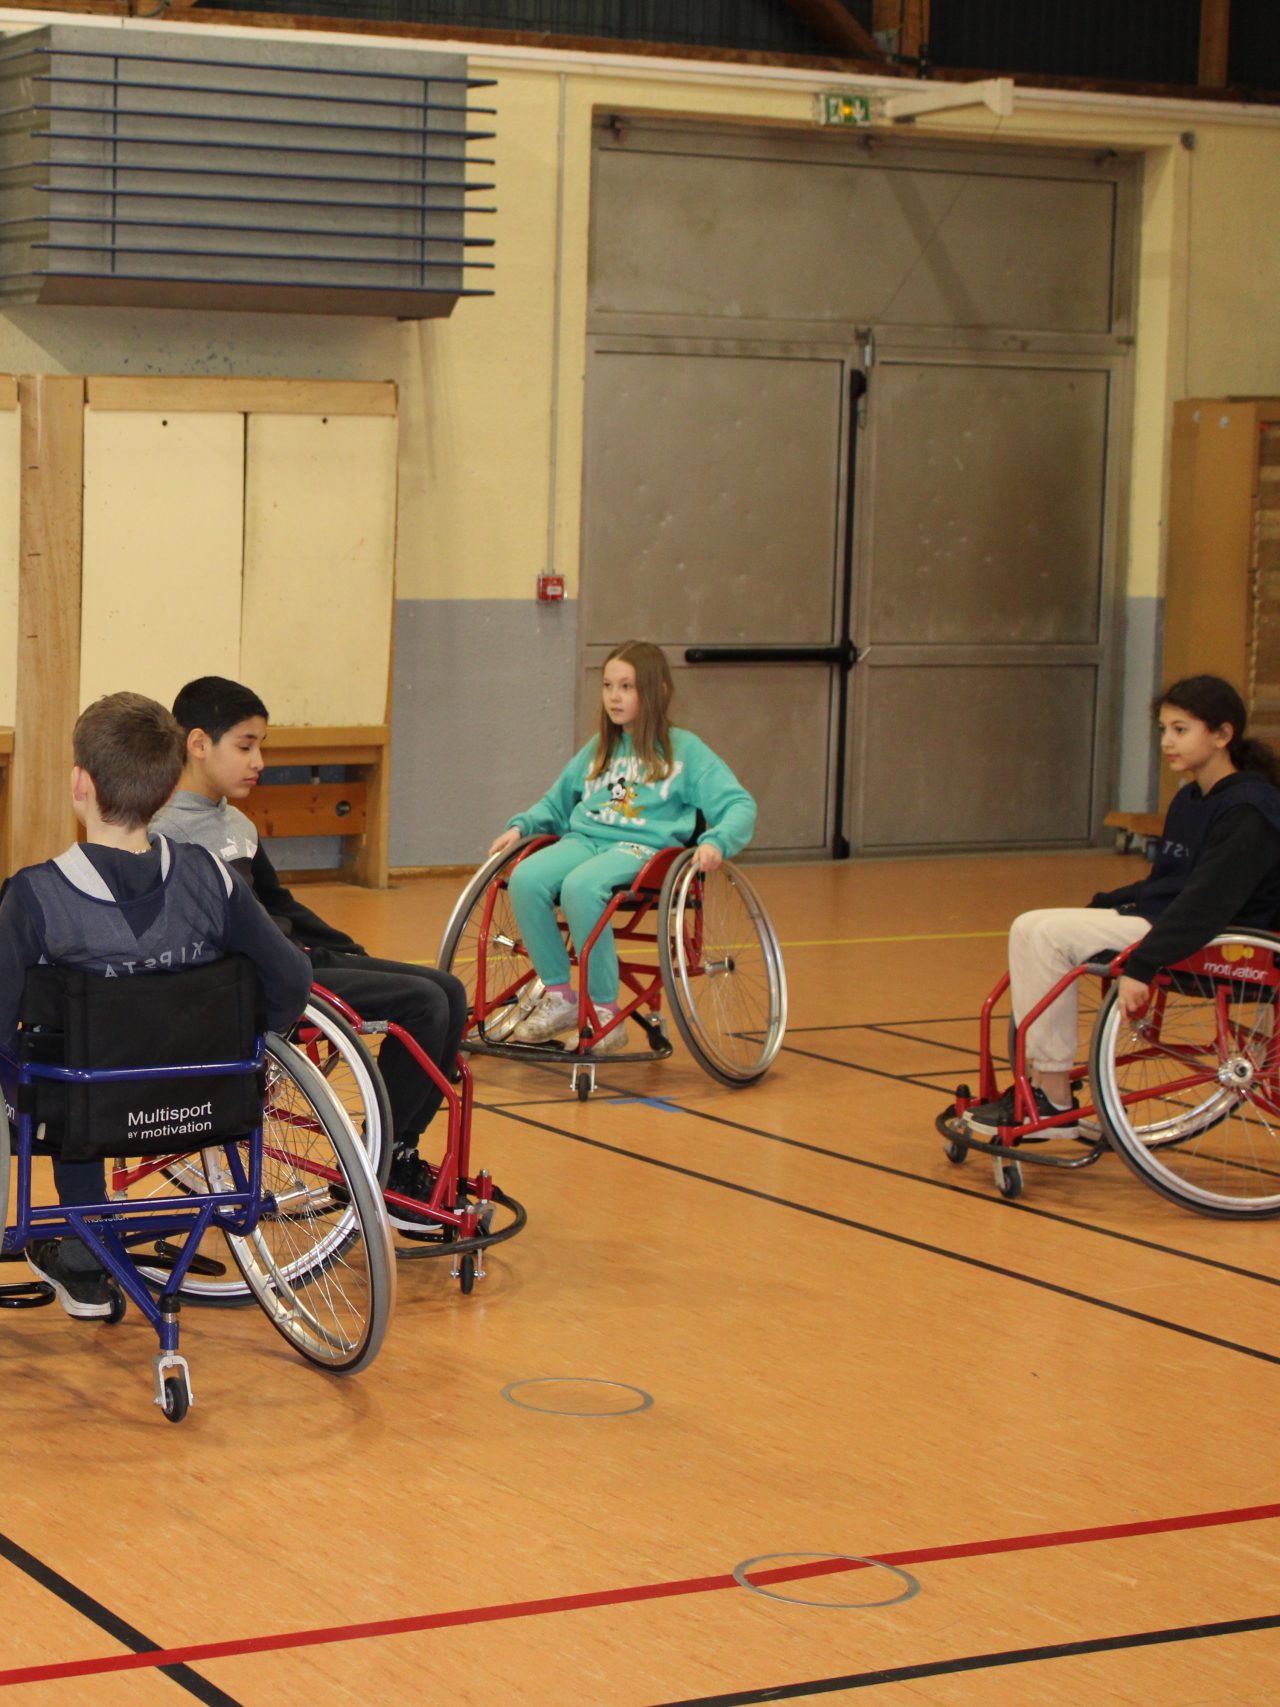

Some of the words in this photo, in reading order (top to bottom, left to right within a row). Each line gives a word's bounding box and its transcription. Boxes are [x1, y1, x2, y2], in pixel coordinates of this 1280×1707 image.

[128, 1101, 212, 1127] Multisport
[127, 1131, 138, 1139] BY
[140, 1121, 212, 1140] motivation
